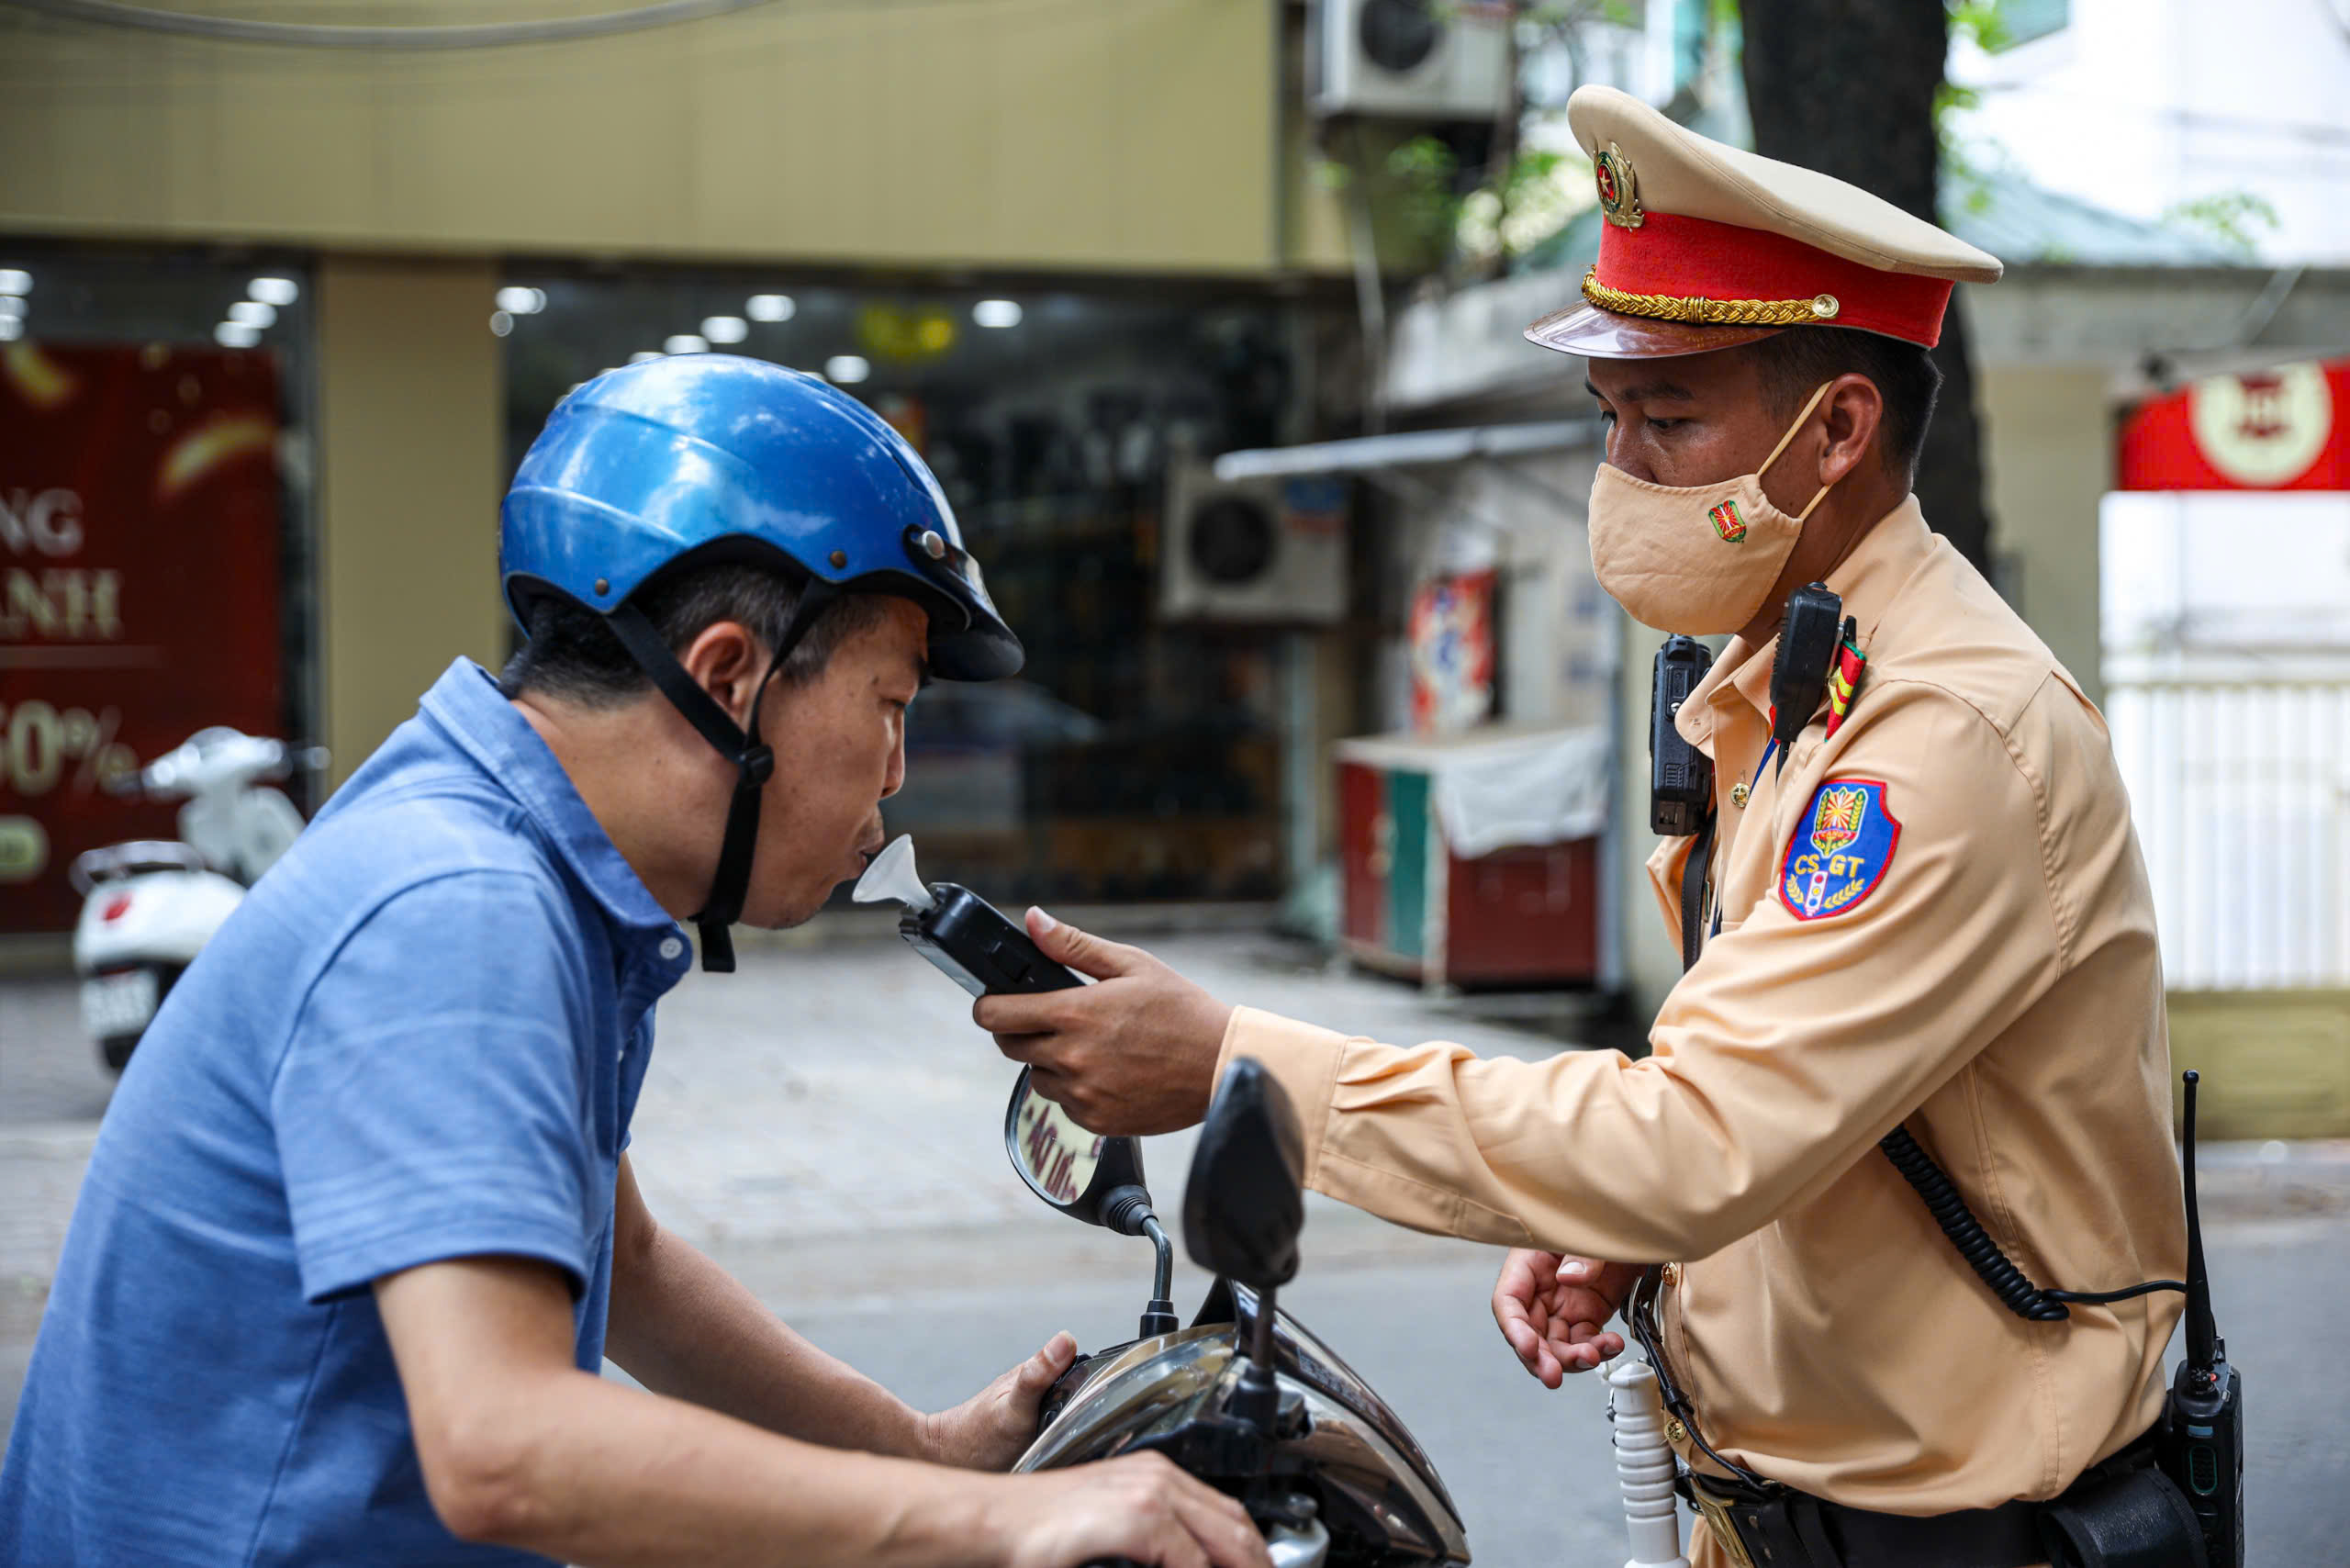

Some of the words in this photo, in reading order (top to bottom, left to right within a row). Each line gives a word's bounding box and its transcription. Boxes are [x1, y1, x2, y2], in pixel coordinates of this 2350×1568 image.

[0, 700, 139, 797] 0%
[1795, 854, 1819, 875] CS
[1829, 855, 1865, 879] GT
